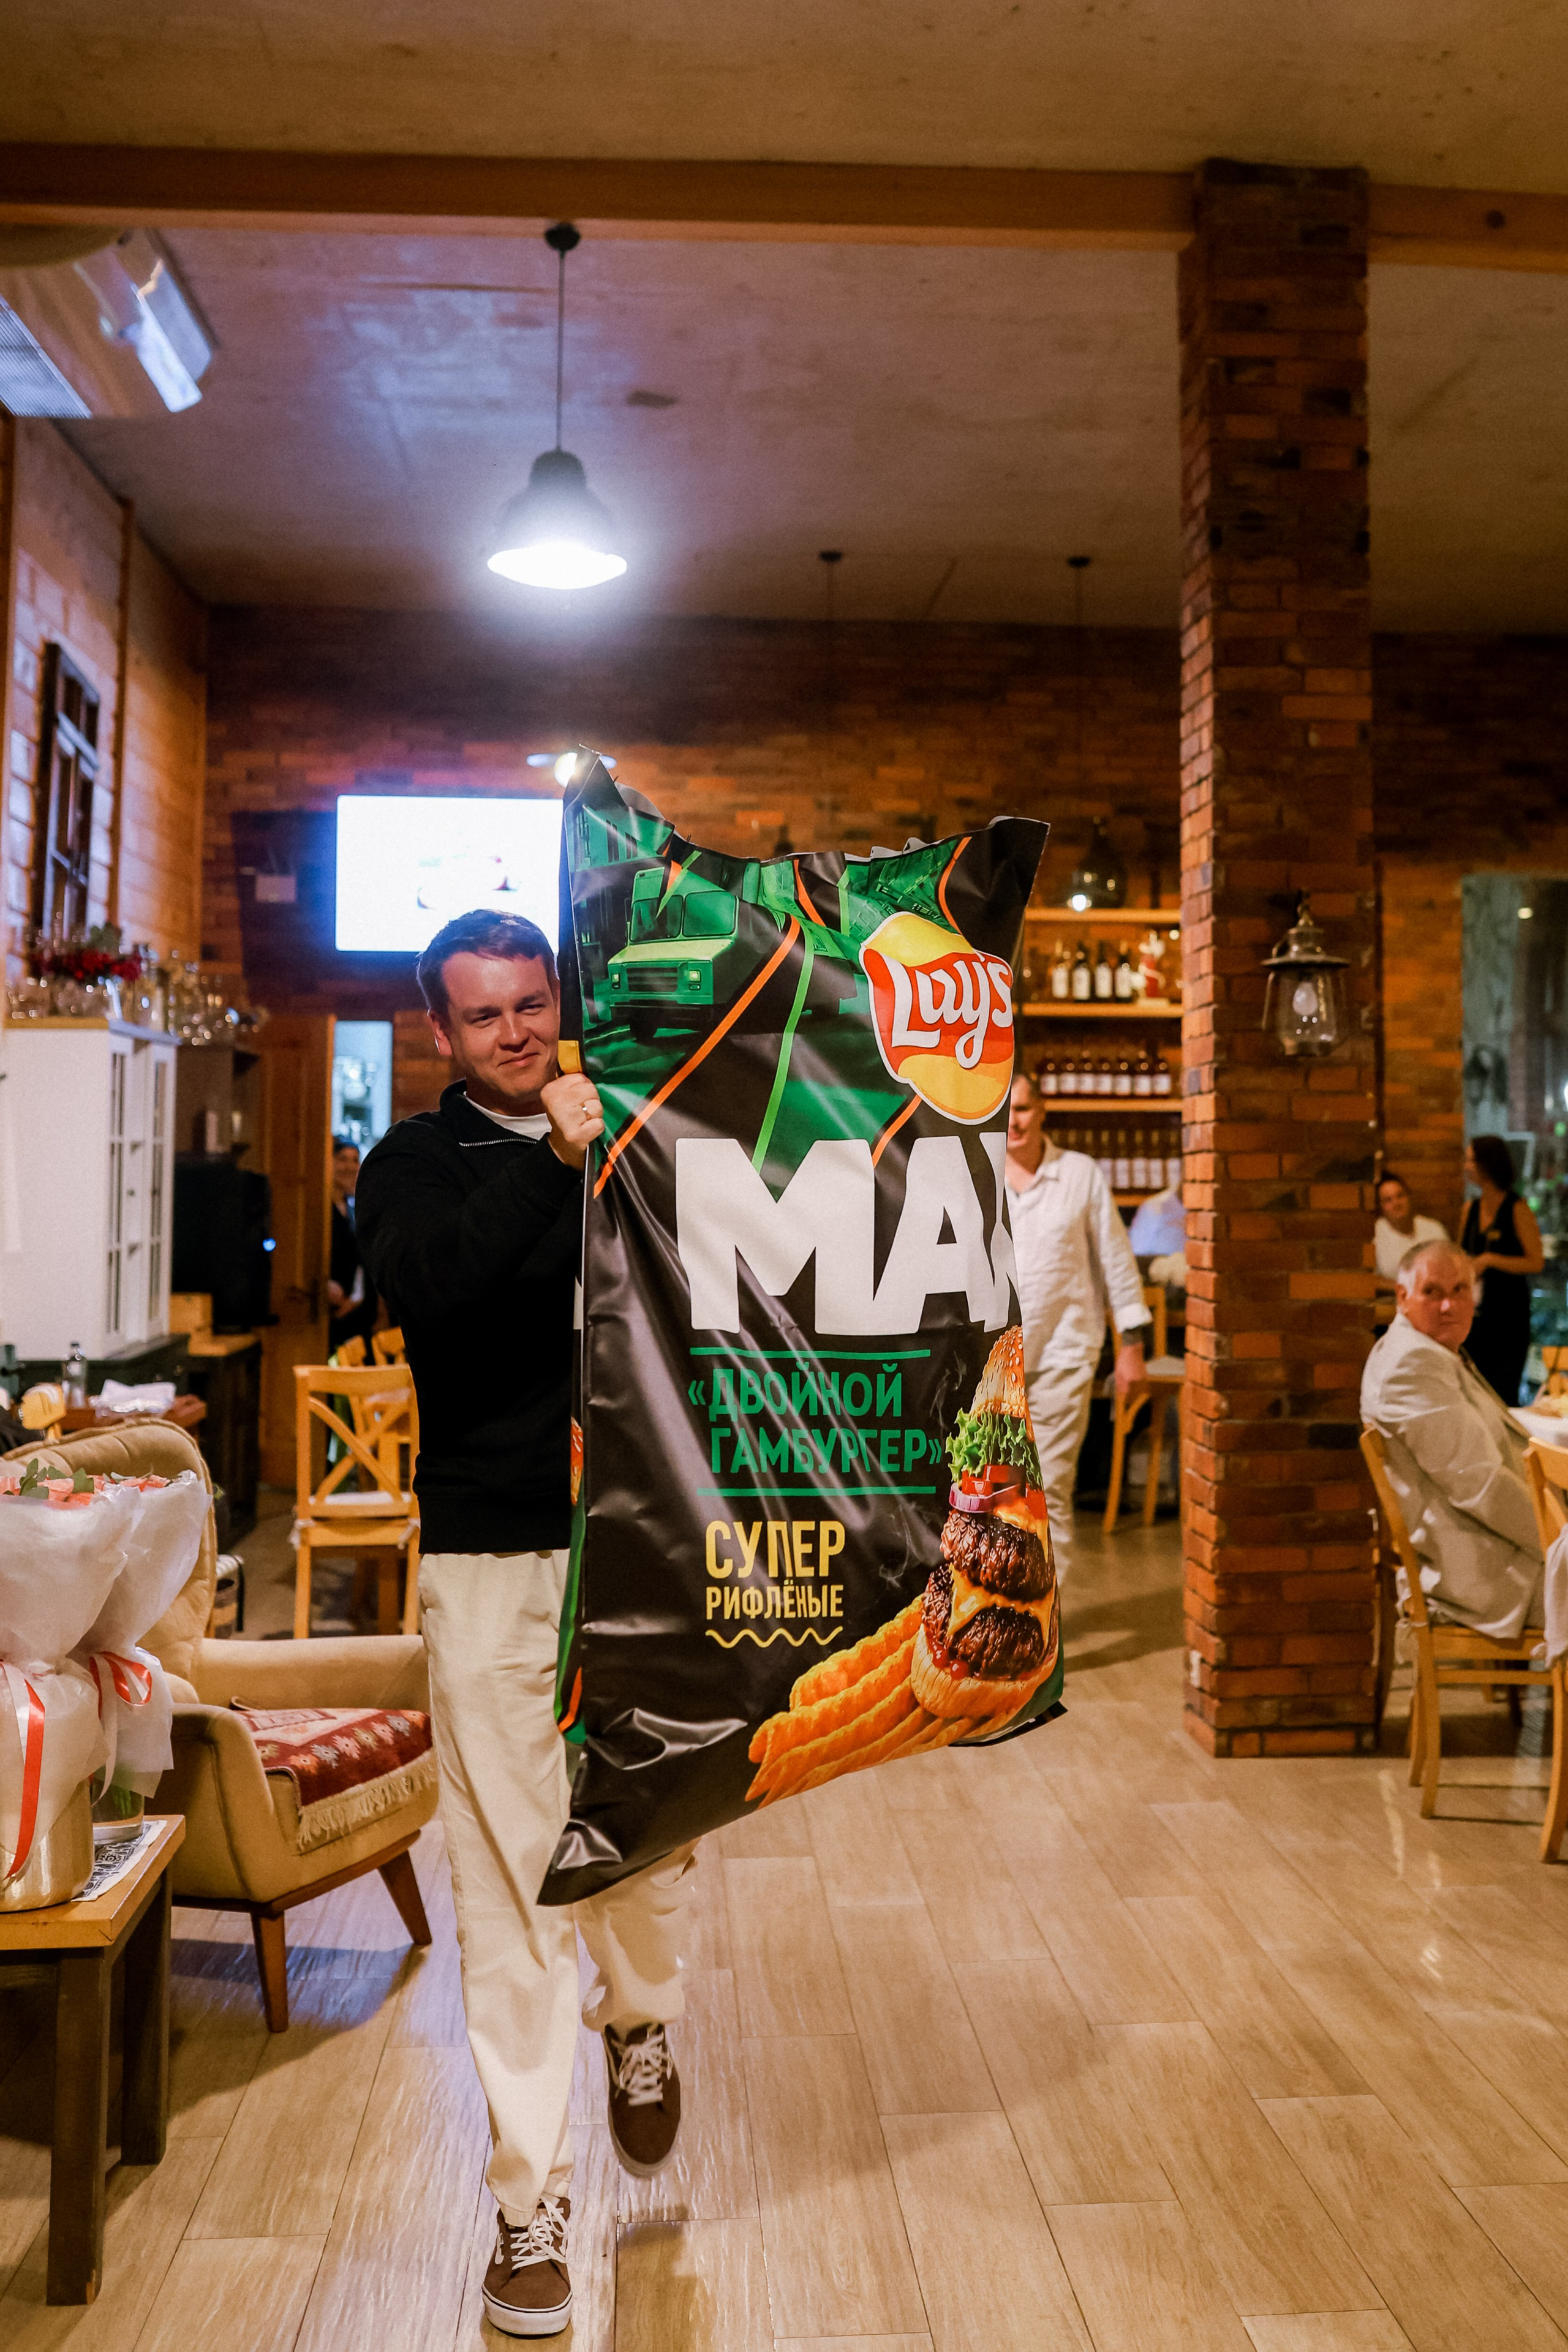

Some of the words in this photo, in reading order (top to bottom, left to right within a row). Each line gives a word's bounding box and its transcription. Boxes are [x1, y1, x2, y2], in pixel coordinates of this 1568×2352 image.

[880, 951, 1013, 1069] Lay's
[688, 1362, 902, 1422] «ДВОЙНОЙ
[711, 1428, 942, 1474] ГАМБУРГЕР»
[706, 1520, 845, 1578] СУПЕР
[706, 1579, 843, 1620] РИФЛЁНЫЕ
